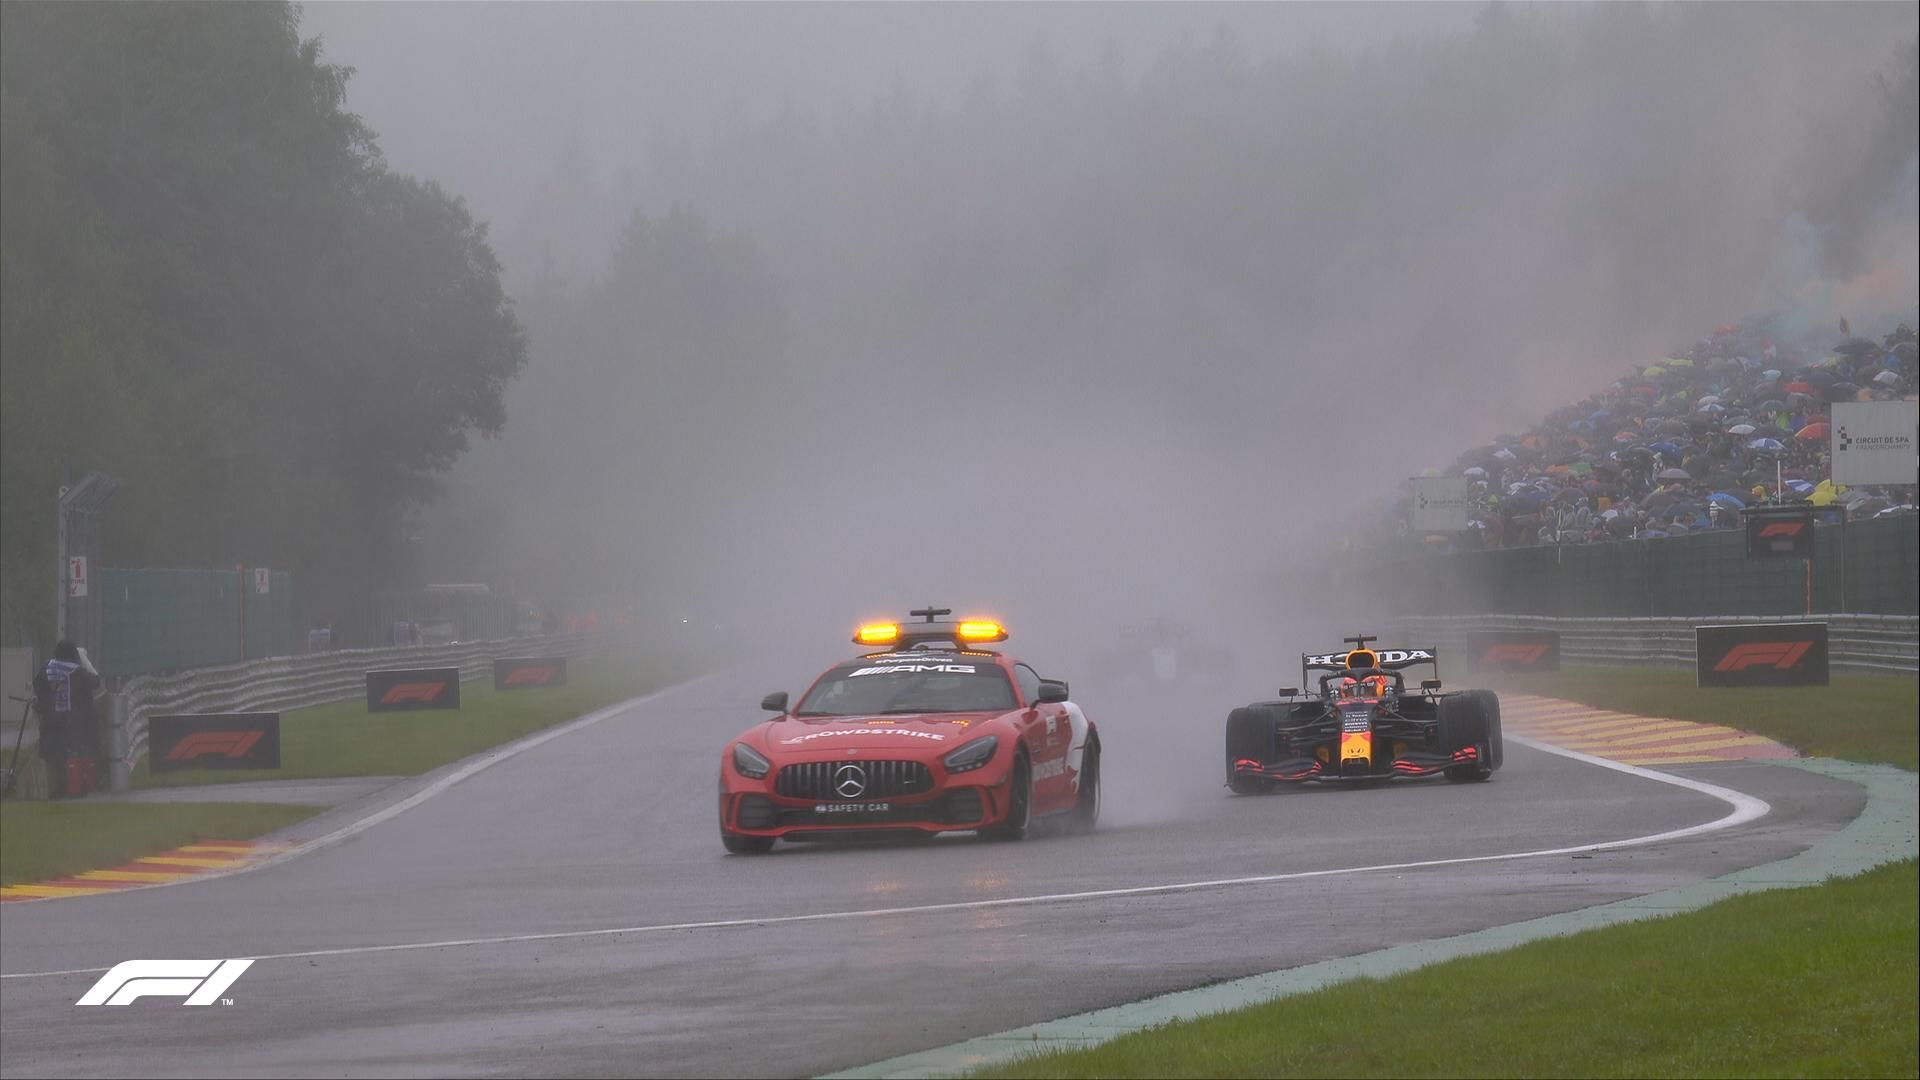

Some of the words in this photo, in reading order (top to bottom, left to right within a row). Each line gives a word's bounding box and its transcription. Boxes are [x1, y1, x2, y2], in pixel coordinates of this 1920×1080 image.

[1884, 436, 1894, 444] DE
[1760, 522, 1804, 537] F1
[1712, 640, 1815, 672] F1
[380, 681, 447, 704] F1
[165, 731, 265, 760] F1
[828, 803, 864, 813] SAFETY
[867, 803, 888, 812] CAR
